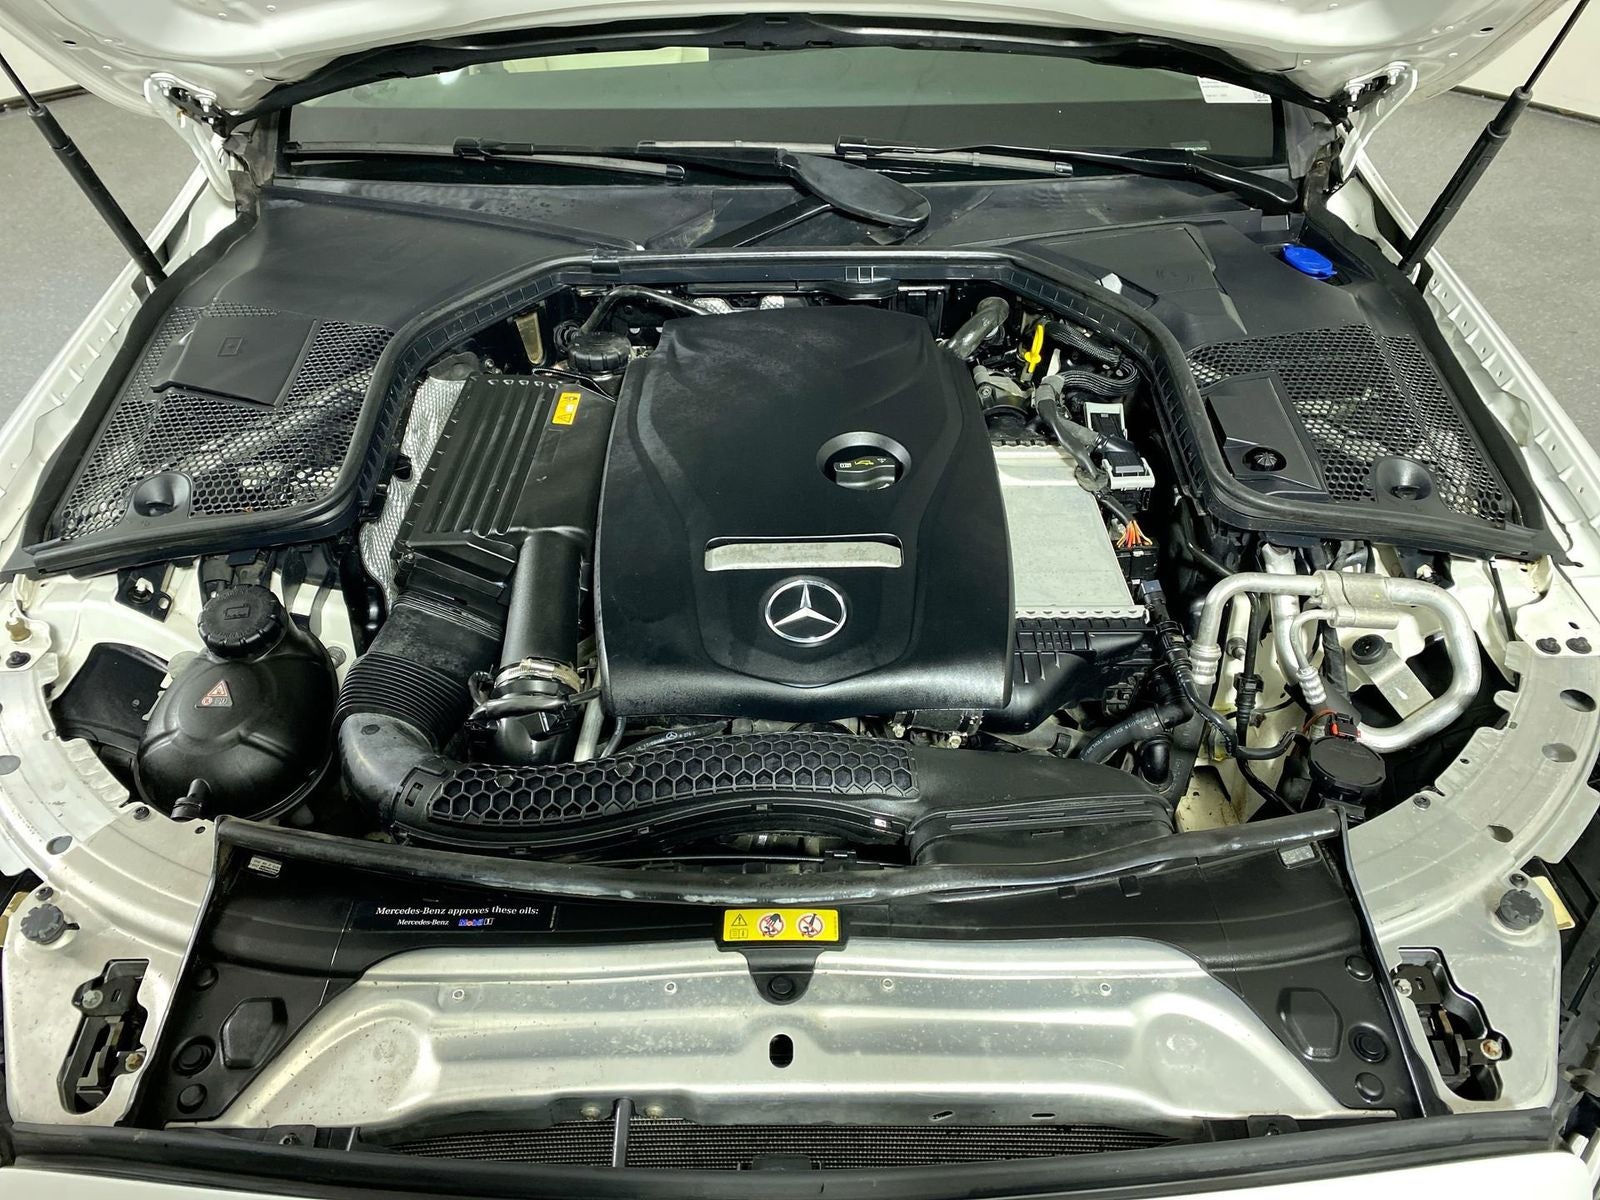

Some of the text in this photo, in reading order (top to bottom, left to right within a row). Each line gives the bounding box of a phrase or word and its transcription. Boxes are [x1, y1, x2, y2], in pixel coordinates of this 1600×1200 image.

[375, 905, 539, 916] Mercedes-Benz approves these oils:
